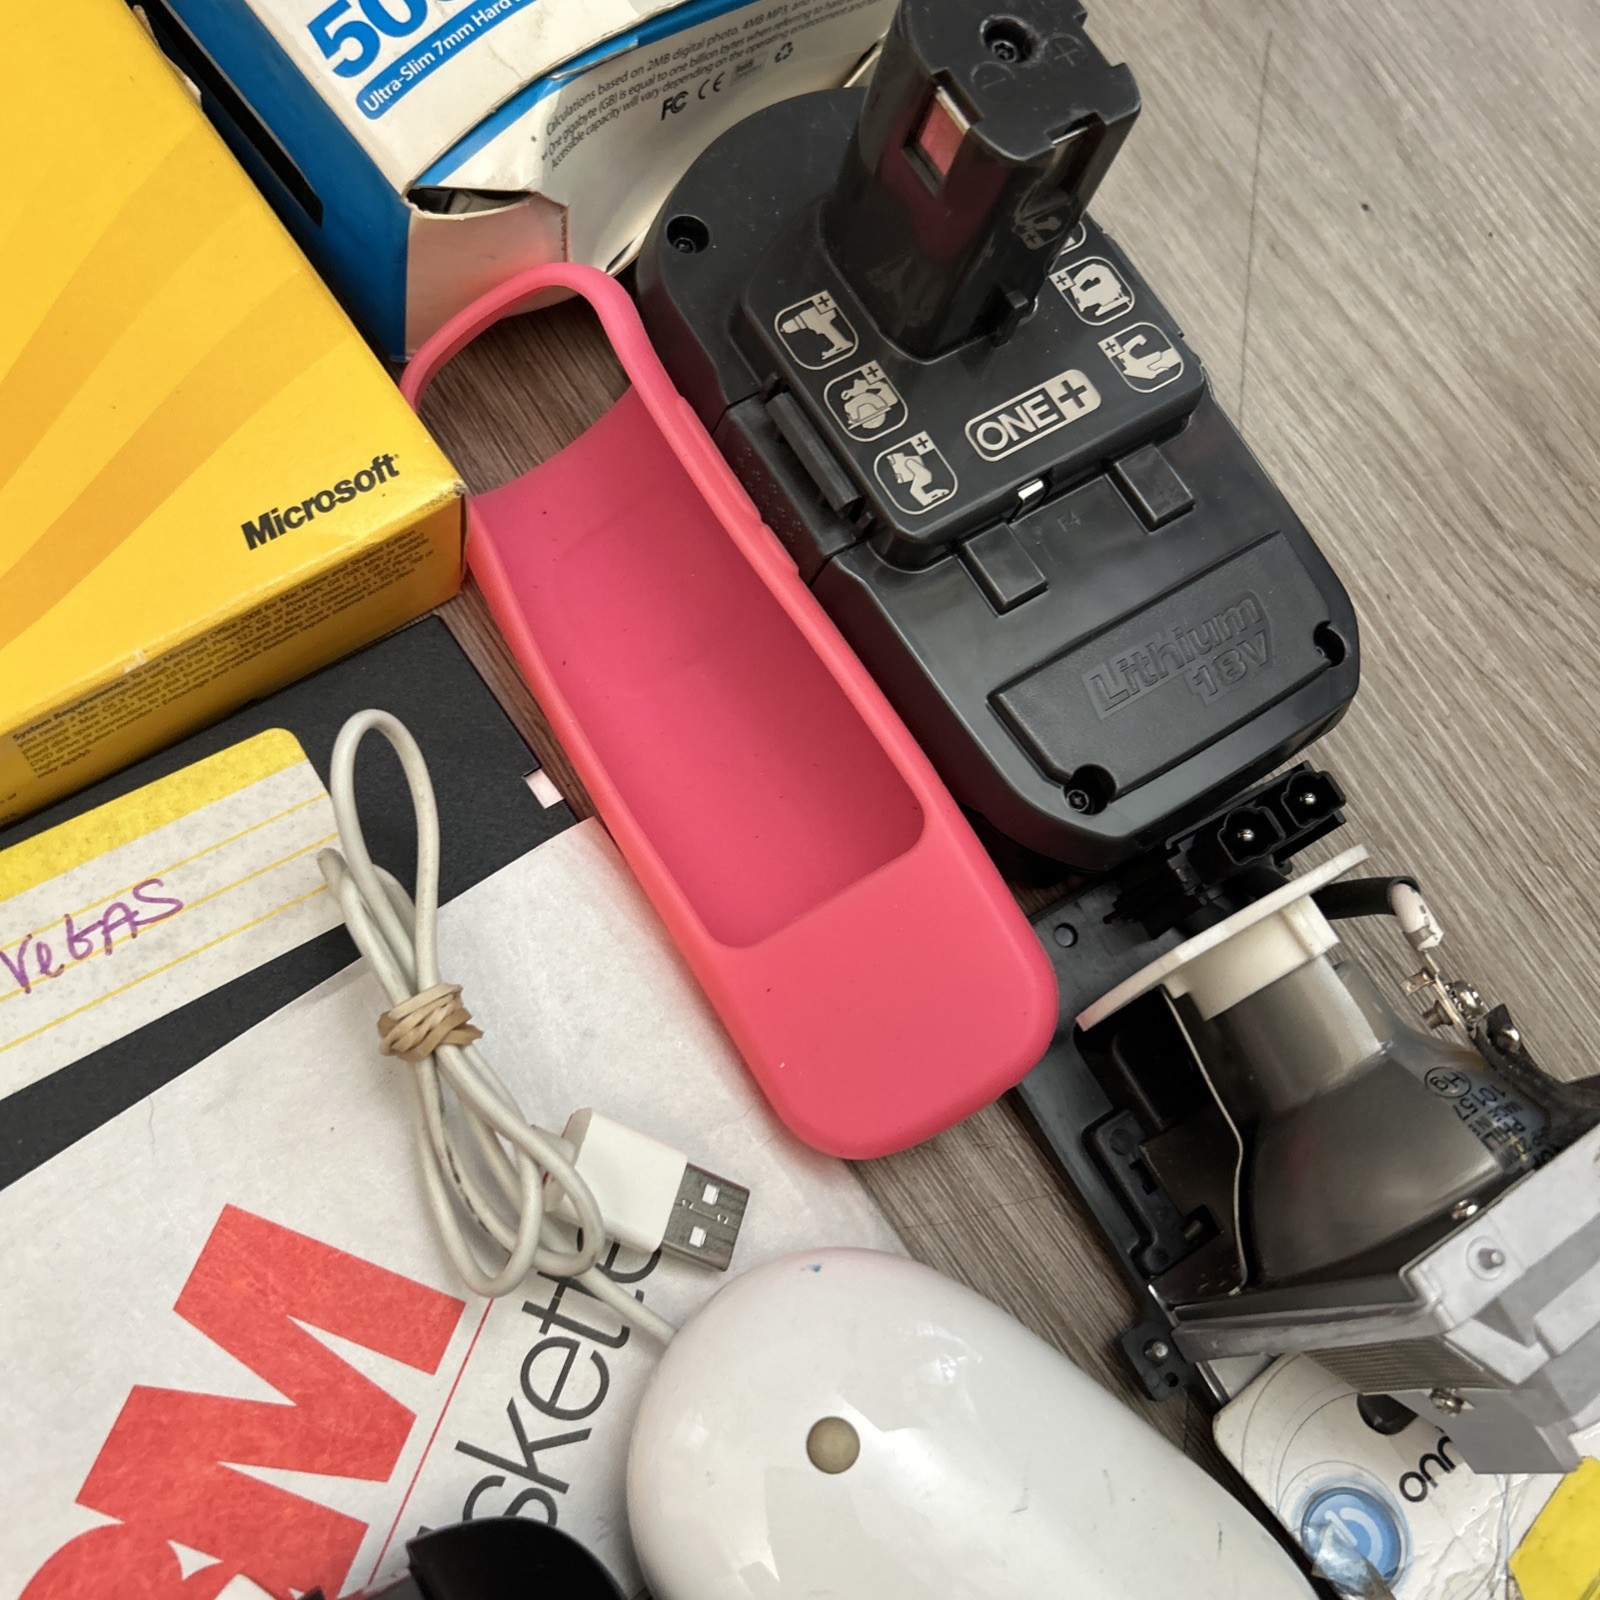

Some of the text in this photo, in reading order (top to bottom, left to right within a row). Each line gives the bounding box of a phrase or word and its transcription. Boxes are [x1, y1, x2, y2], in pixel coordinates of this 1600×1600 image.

[307, 0, 452, 78] 50
[363, 51, 436, 112] Ultra-Slim
[431, 23, 475, 56] 7mm
[628, 74, 656, 96] equal
[657, 72, 668, 82] to
[669, 63, 688, 77] one
[689, 49, 719, 67] billion
[720, 37, 745, 54] bytes
[546, 91, 596, 136] Calculations
[598, 70, 628, 95] based
[630, 66, 645, 79] on
[647, 53, 671, 71] 2MB
[672, 37, 706, 60] digital
[623, 94, 639, 112] will
[640, 88, 660, 102] vary
[662, 63, 714, 92] depending
[715, 57, 728, 68] on
[729, 49, 744, 62] the
[241, 452, 399, 550] Microsoft
[1089, 596, 1264, 711] Lithium
[1191, 632, 1270, 697] 18V
[1452, 1085, 1506, 1121] 10157
